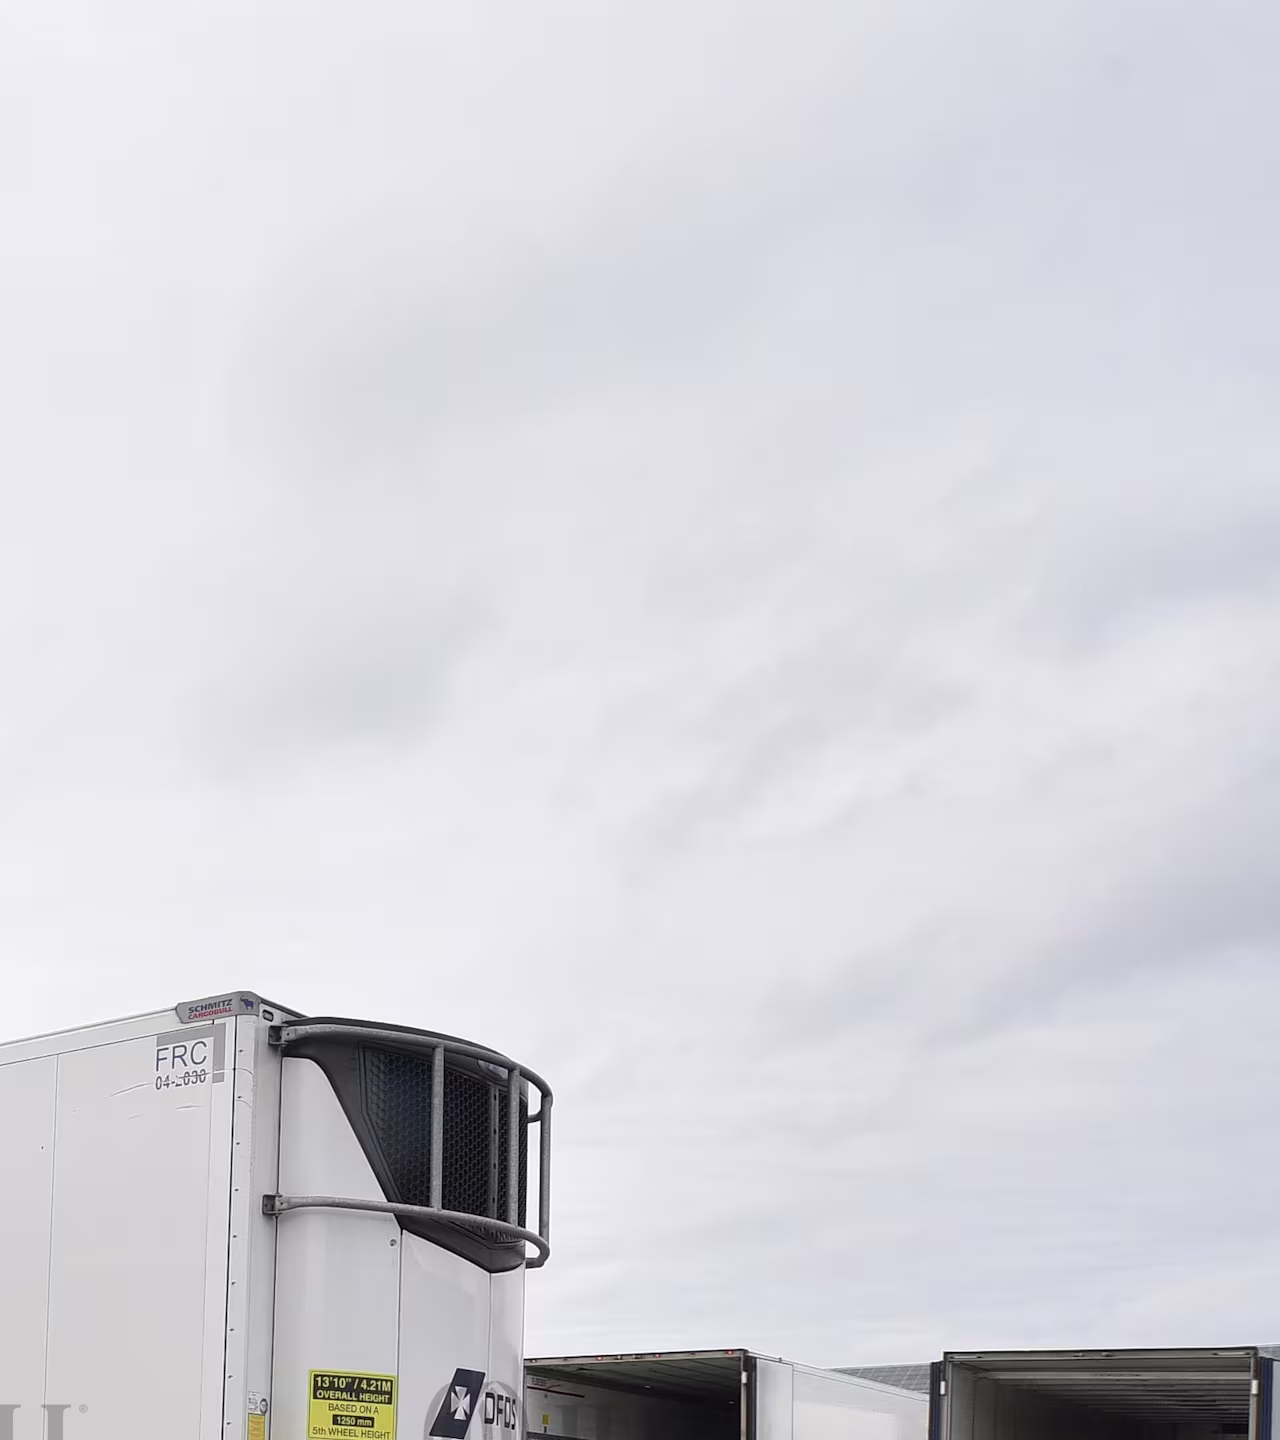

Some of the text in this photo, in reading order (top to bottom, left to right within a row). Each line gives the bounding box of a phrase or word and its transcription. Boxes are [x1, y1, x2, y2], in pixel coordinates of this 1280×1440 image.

[188, 999, 234, 1014] SCHMITZ
[188, 1006, 234, 1020] CARGOBULL
[155, 1041, 208, 1072] FRC
[360, 1379, 391, 1392] 4.21M
[316, 1389, 390, 1403] OVERALL HEIGHT
[328, 1402, 380, 1415] BASED ON A
[483, 1391, 517, 1431] DFDS
[336, 1416, 372, 1427] 1250 mm
[312, 1426, 391, 1440] 5th WHEEL HEIGHT
